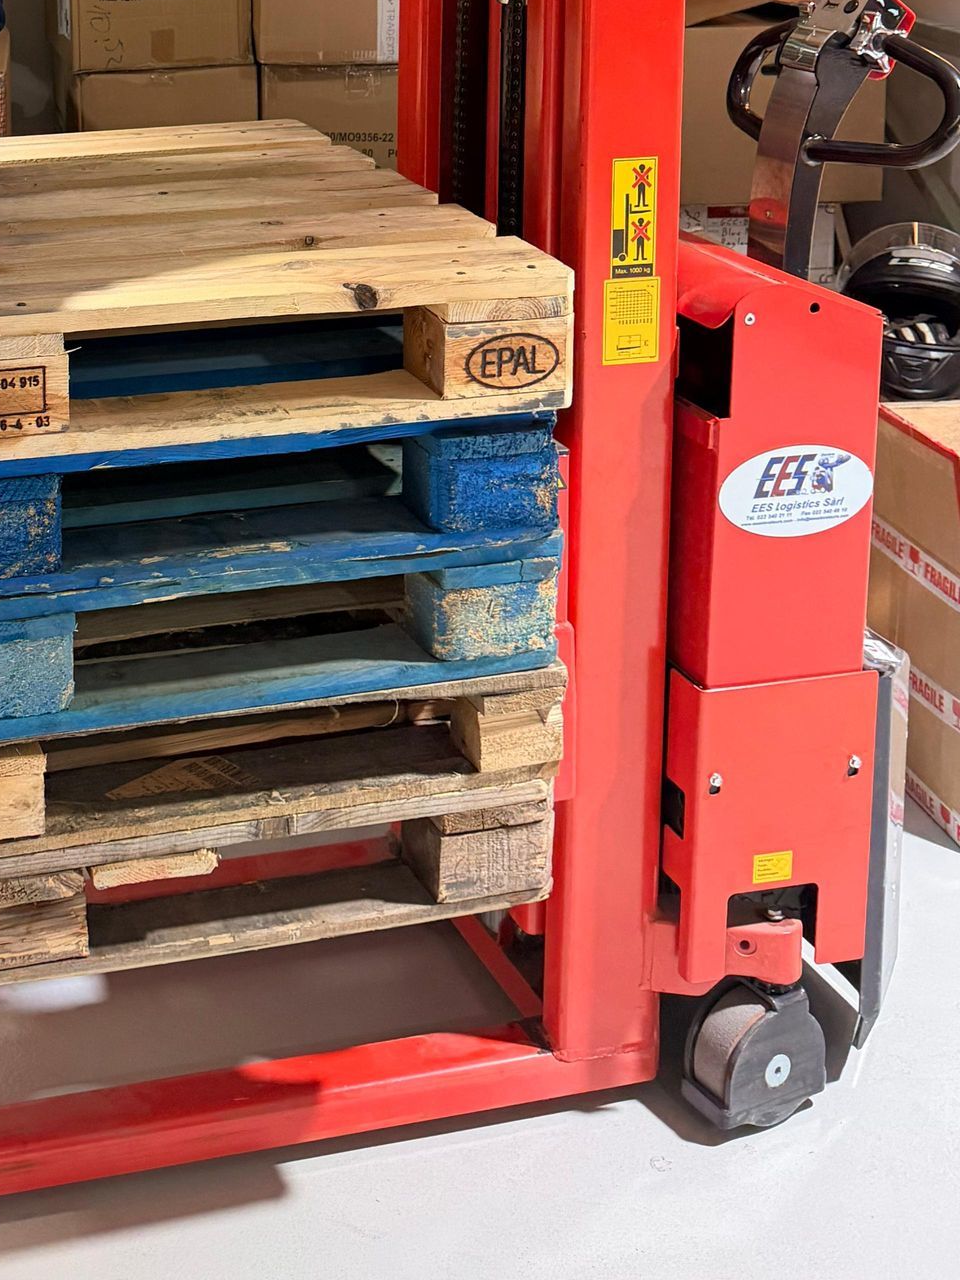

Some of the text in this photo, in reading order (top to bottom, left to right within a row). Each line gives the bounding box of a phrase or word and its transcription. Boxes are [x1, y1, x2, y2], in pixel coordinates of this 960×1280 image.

[480, 345, 546, 379] EPAL
[753, 454, 818, 499] EES
[751, 502, 774, 513] EES
[776, 499, 820, 514] Logistics
[909, 670, 945, 714] FRAGILE
